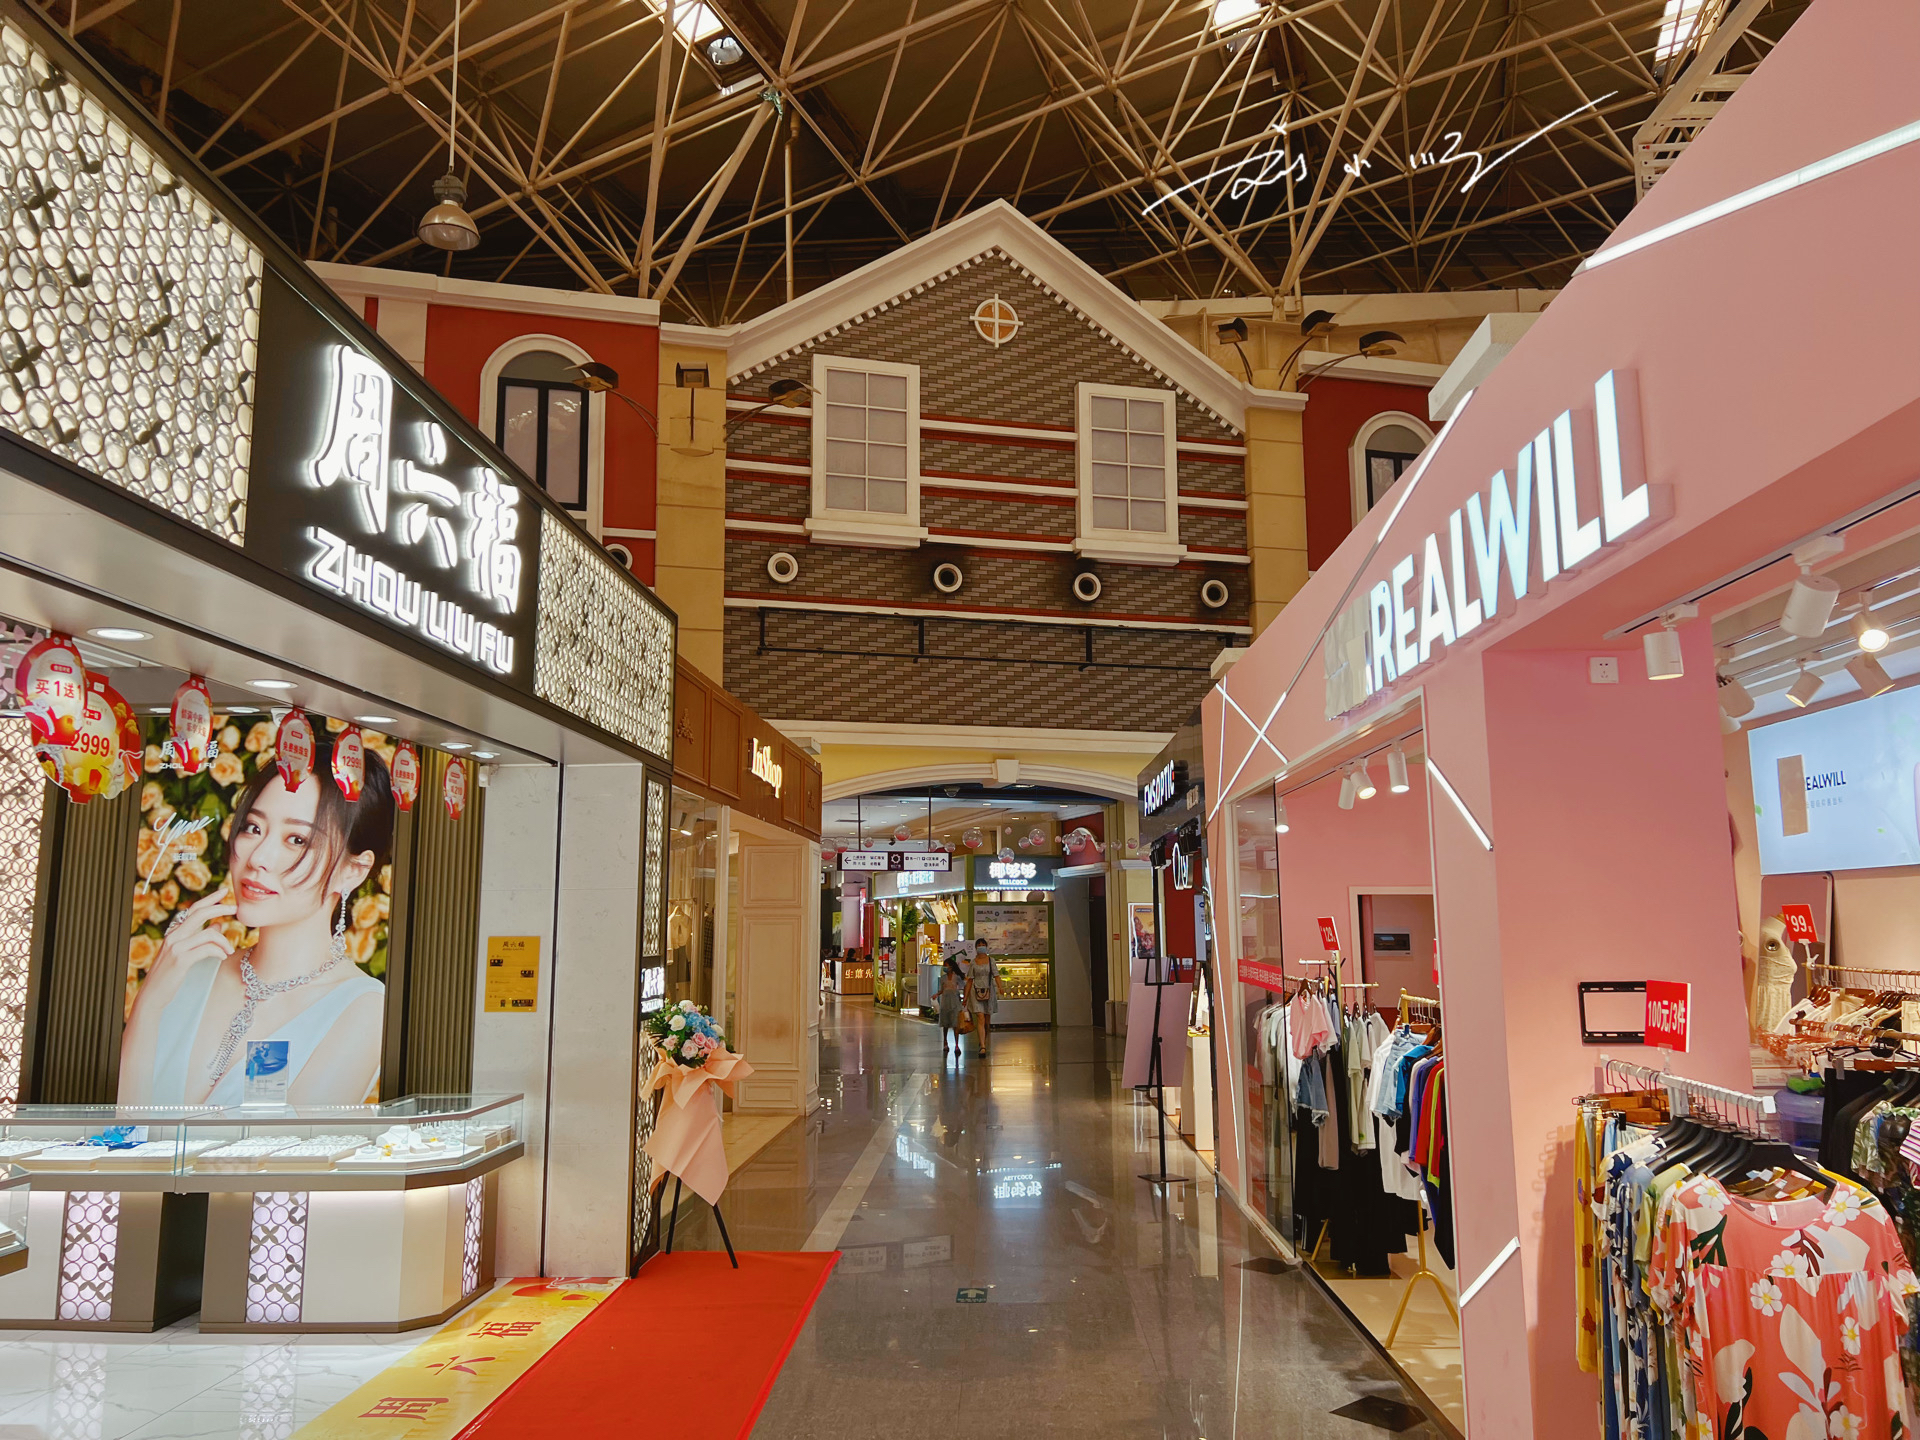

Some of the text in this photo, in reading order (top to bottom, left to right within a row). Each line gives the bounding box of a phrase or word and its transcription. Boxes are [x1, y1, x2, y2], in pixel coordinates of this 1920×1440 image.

[308, 345, 521, 614] 周六福
[1369, 368, 1650, 694] REALWILL
[307, 526, 514, 674] ZHOU LIU FU
[35, 678, 82, 701] 买1送1
[66, 733, 110, 758] 2999
[160, 740, 219, 759] 周福
[751, 737, 783, 799] InShop
[1806, 770, 1847, 791] EALWILL
[988, 862, 1037, 879] 椰够够
[1647, 1000, 1686, 1036] 100元/3件
[358, 1321, 542, 1421] 周六福
